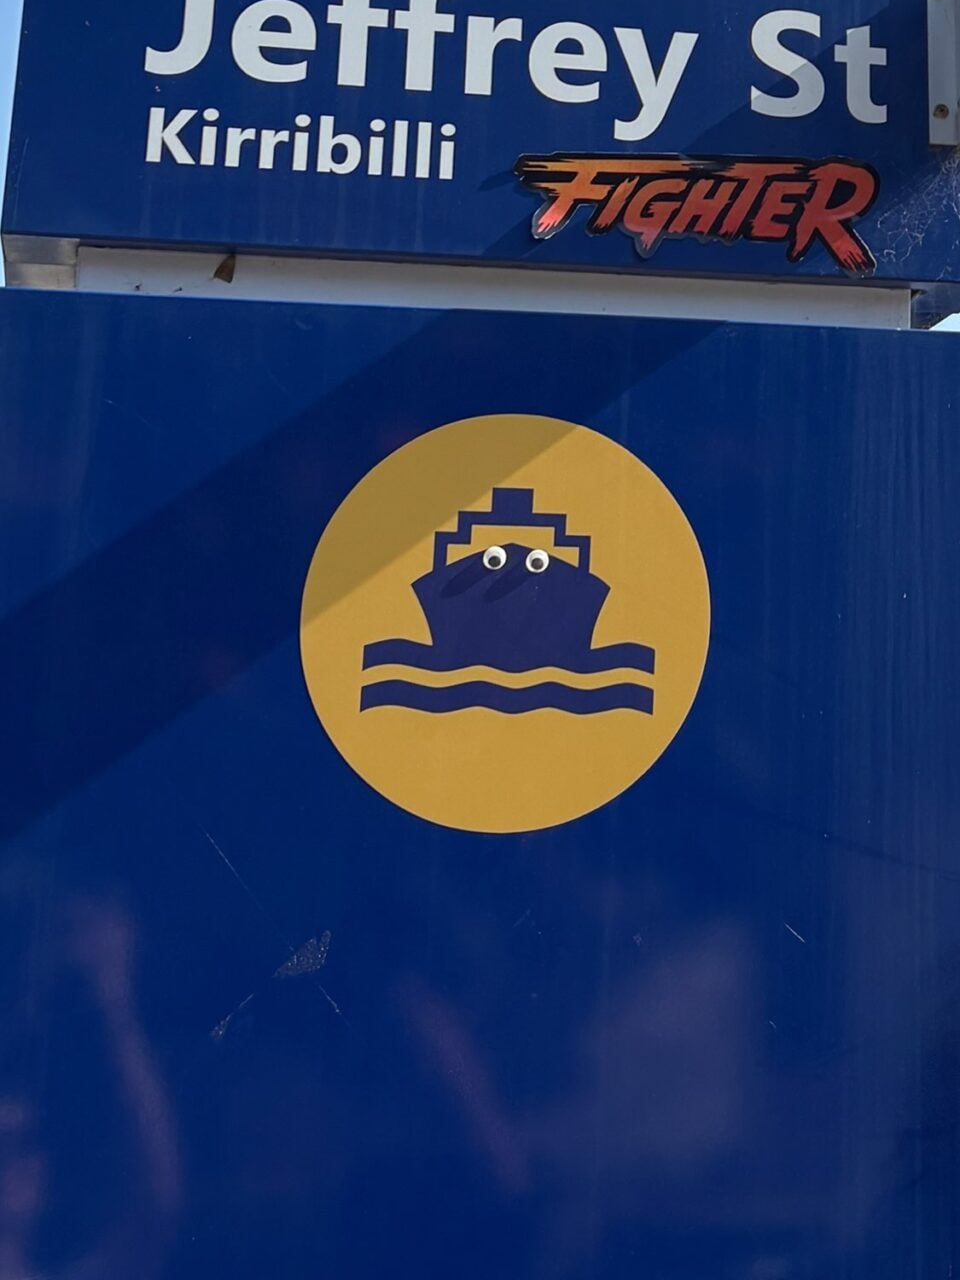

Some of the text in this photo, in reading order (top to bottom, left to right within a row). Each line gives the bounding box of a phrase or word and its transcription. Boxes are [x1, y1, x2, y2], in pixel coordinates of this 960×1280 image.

[750, 9, 887, 123] St
[145, 107, 456, 180] Kirribilli
[522, 158, 876, 273] FIGHTER
